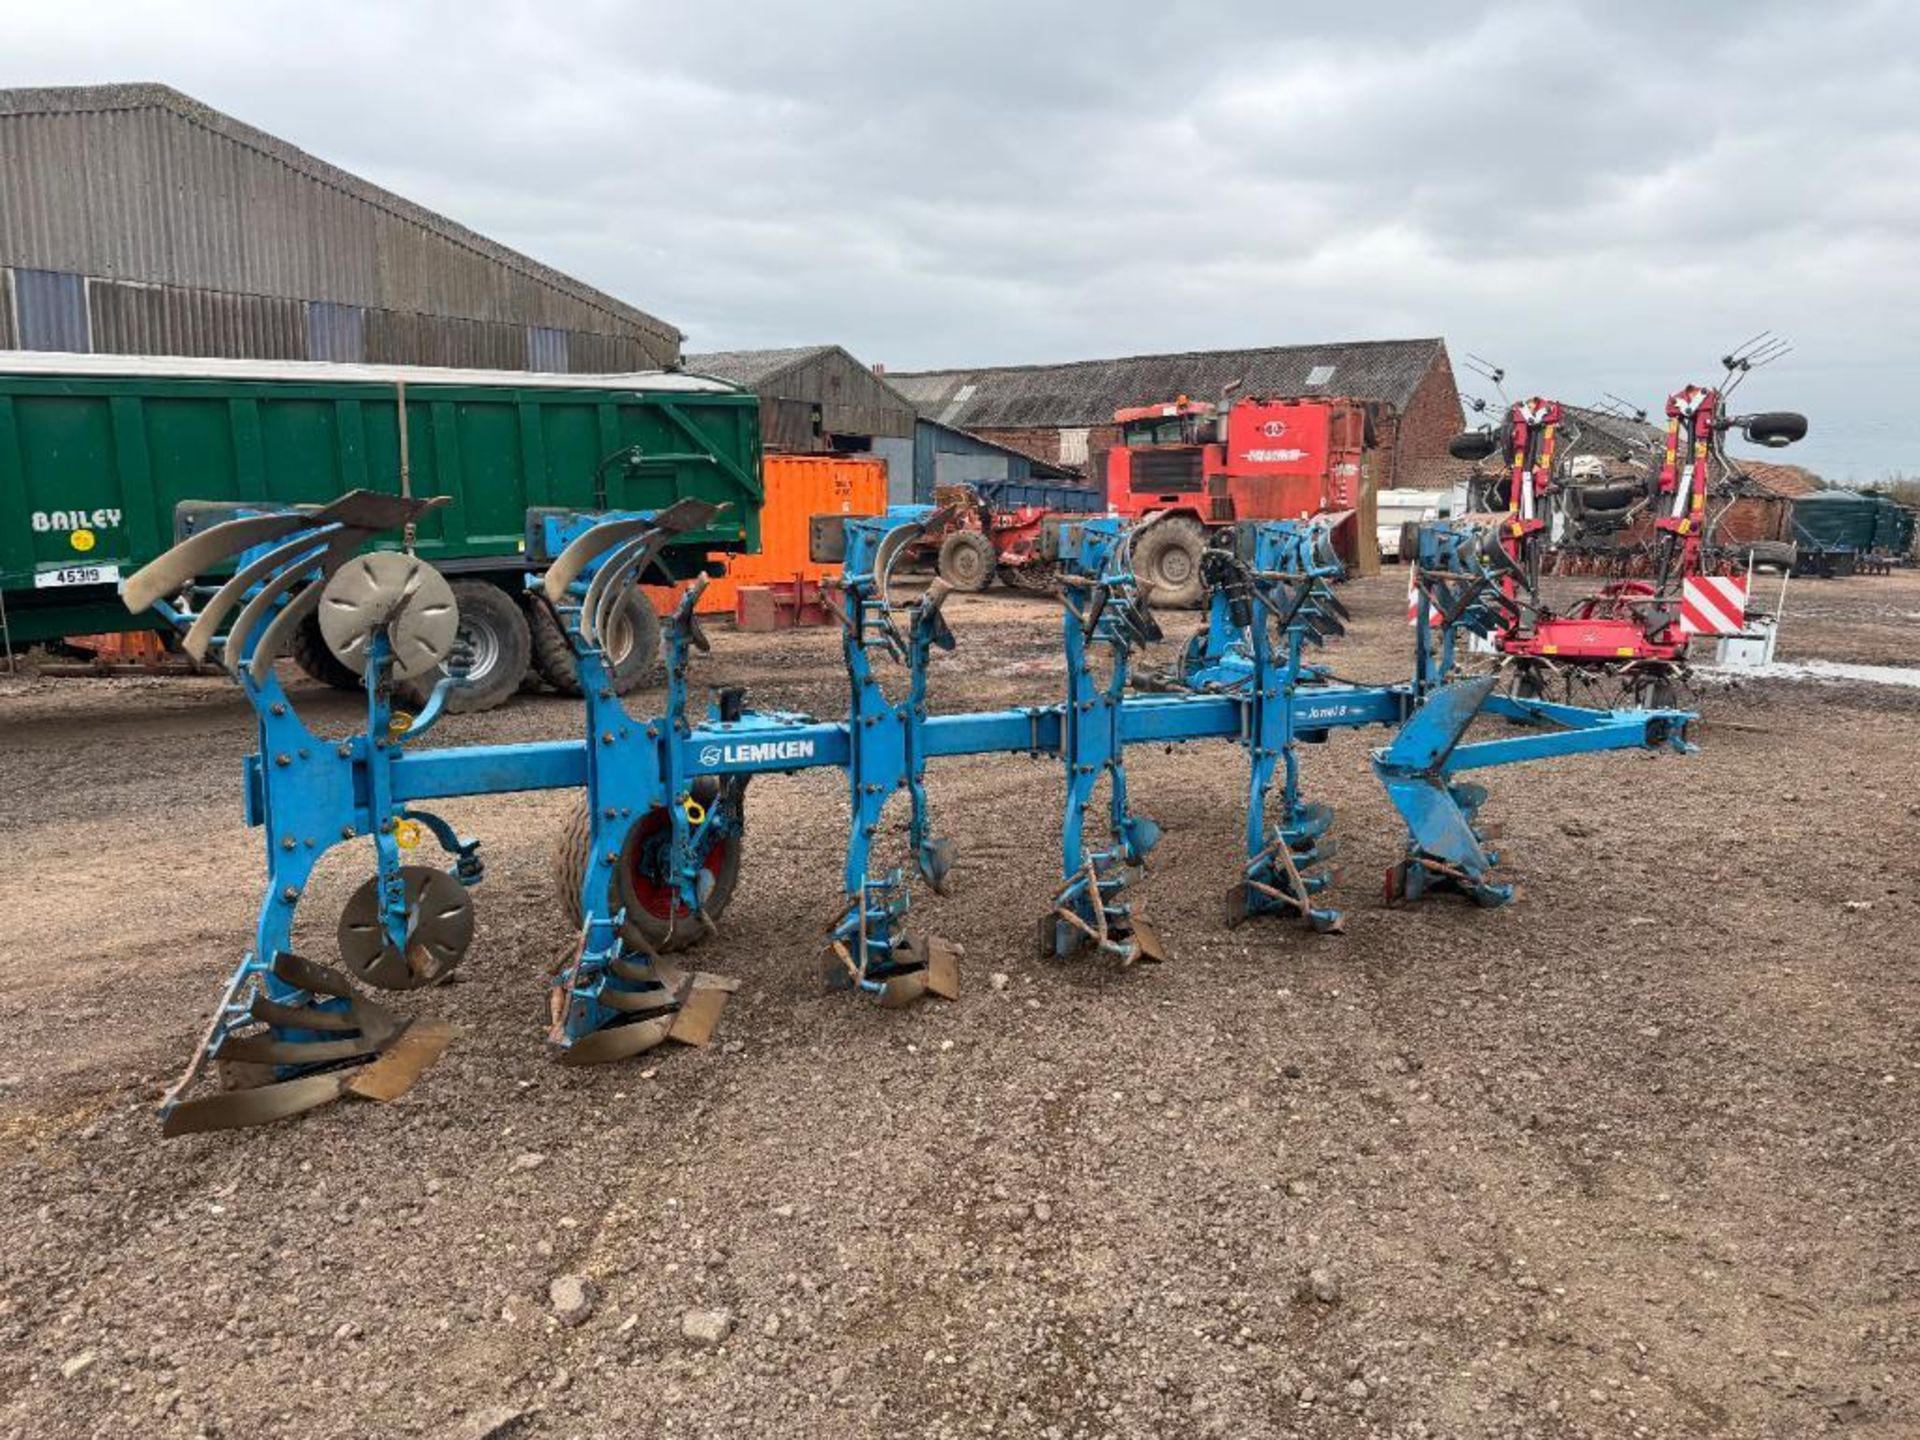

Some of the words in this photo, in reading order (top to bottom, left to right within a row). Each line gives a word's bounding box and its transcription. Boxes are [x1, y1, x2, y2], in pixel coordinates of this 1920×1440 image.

[32, 508, 122, 531] BAILEY
[57, 568, 99, 583] 45319
[724, 740, 814, 763] LEMKEN
